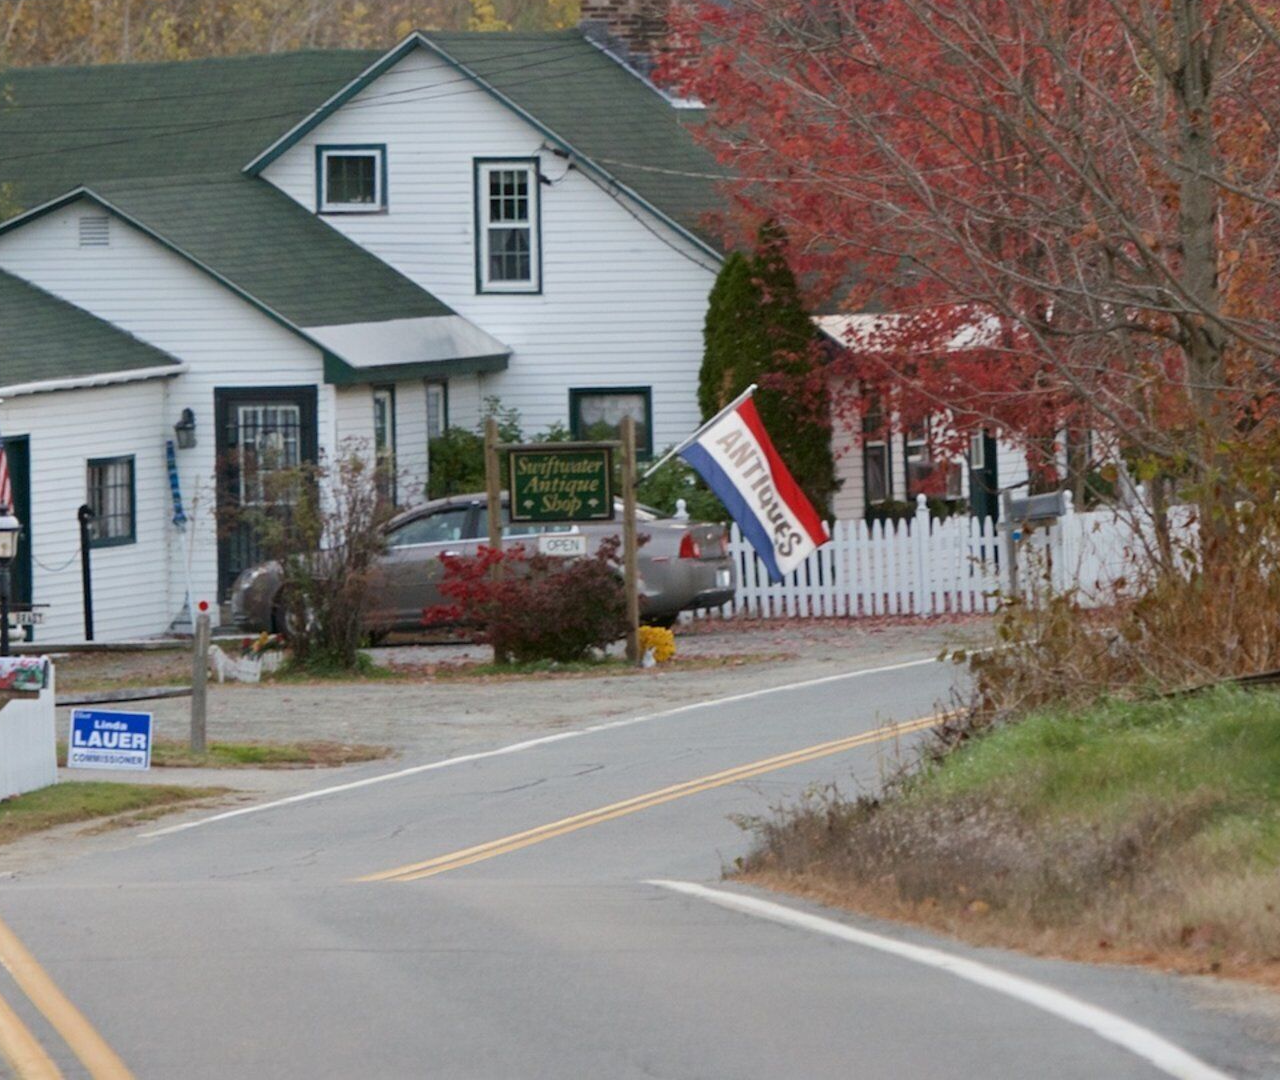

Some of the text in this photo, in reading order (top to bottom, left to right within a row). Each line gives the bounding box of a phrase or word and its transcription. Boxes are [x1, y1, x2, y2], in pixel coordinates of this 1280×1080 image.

[517, 455, 603, 479] Swiftwater
[523, 476, 600, 497] Antique
[716, 429, 803, 557] ANTIQUES
[540, 493, 582, 517] Shop
[547, 539, 580, 552] OPEN
[94, 720, 128, 731] Linda
[74, 729, 147, 749] LAUER
[73, 753, 144, 765] COMMISSIONER
